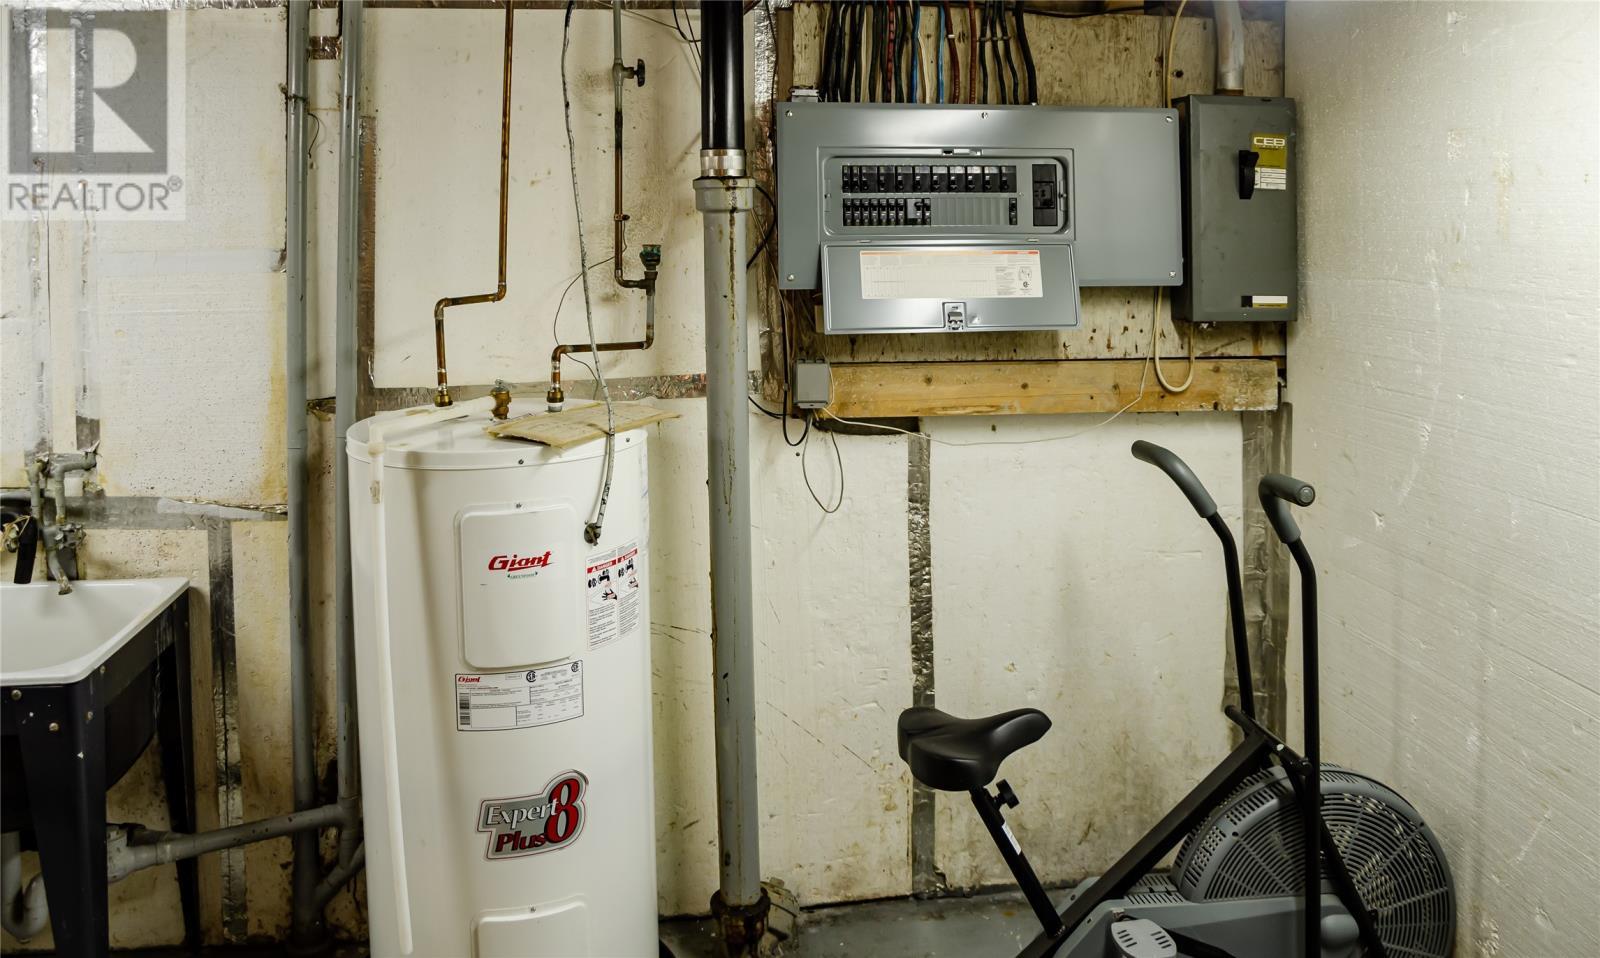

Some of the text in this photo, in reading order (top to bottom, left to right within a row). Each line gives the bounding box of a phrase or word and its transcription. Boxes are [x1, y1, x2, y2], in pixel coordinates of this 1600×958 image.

[488, 551, 553, 572] Giant
[486, 778, 581, 844] Expert 8
[495, 831, 546, 853] Plus
